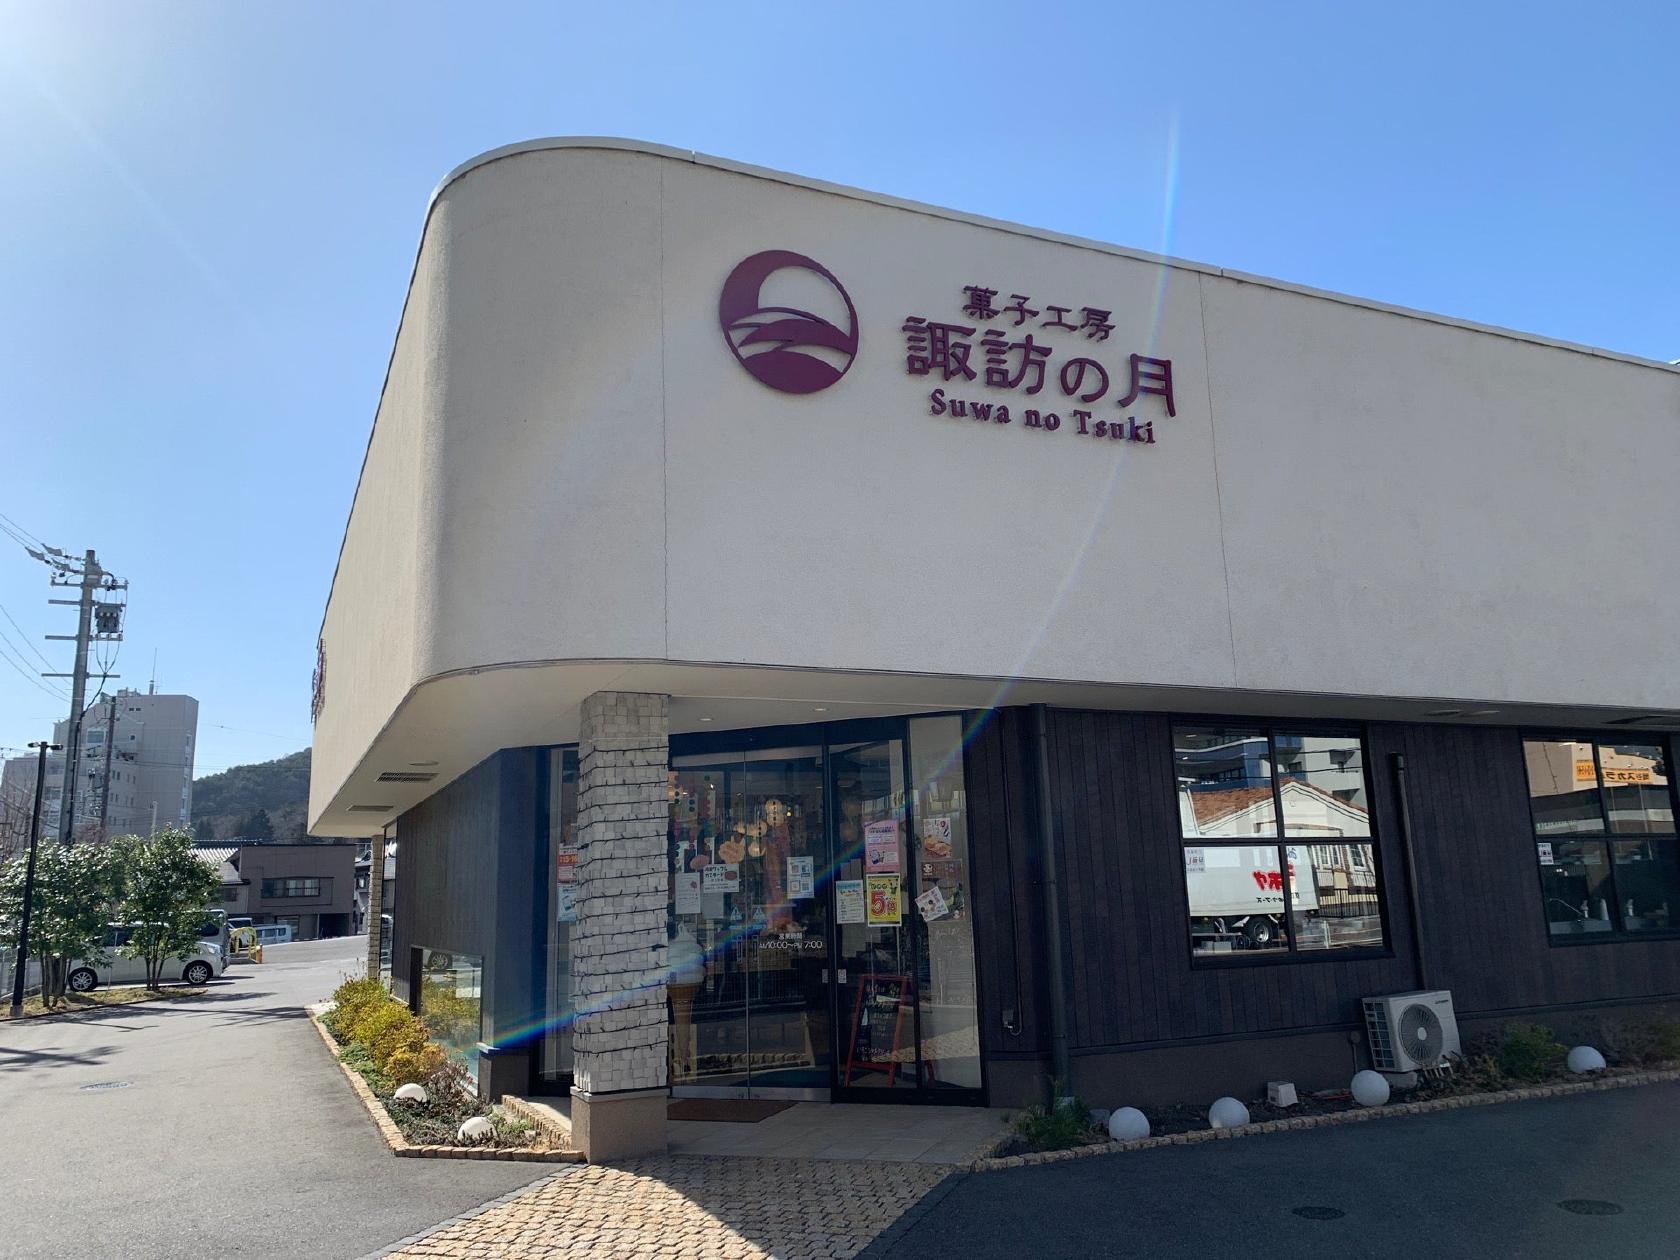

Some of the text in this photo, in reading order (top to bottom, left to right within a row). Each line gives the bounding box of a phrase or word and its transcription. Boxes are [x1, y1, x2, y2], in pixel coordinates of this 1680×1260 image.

[963, 285, 1116, 342] 菓子工房
[902, 316, 1177, 417] 諏訪の月
[930, 388, 1156, 443] Suwa no Tsuki
